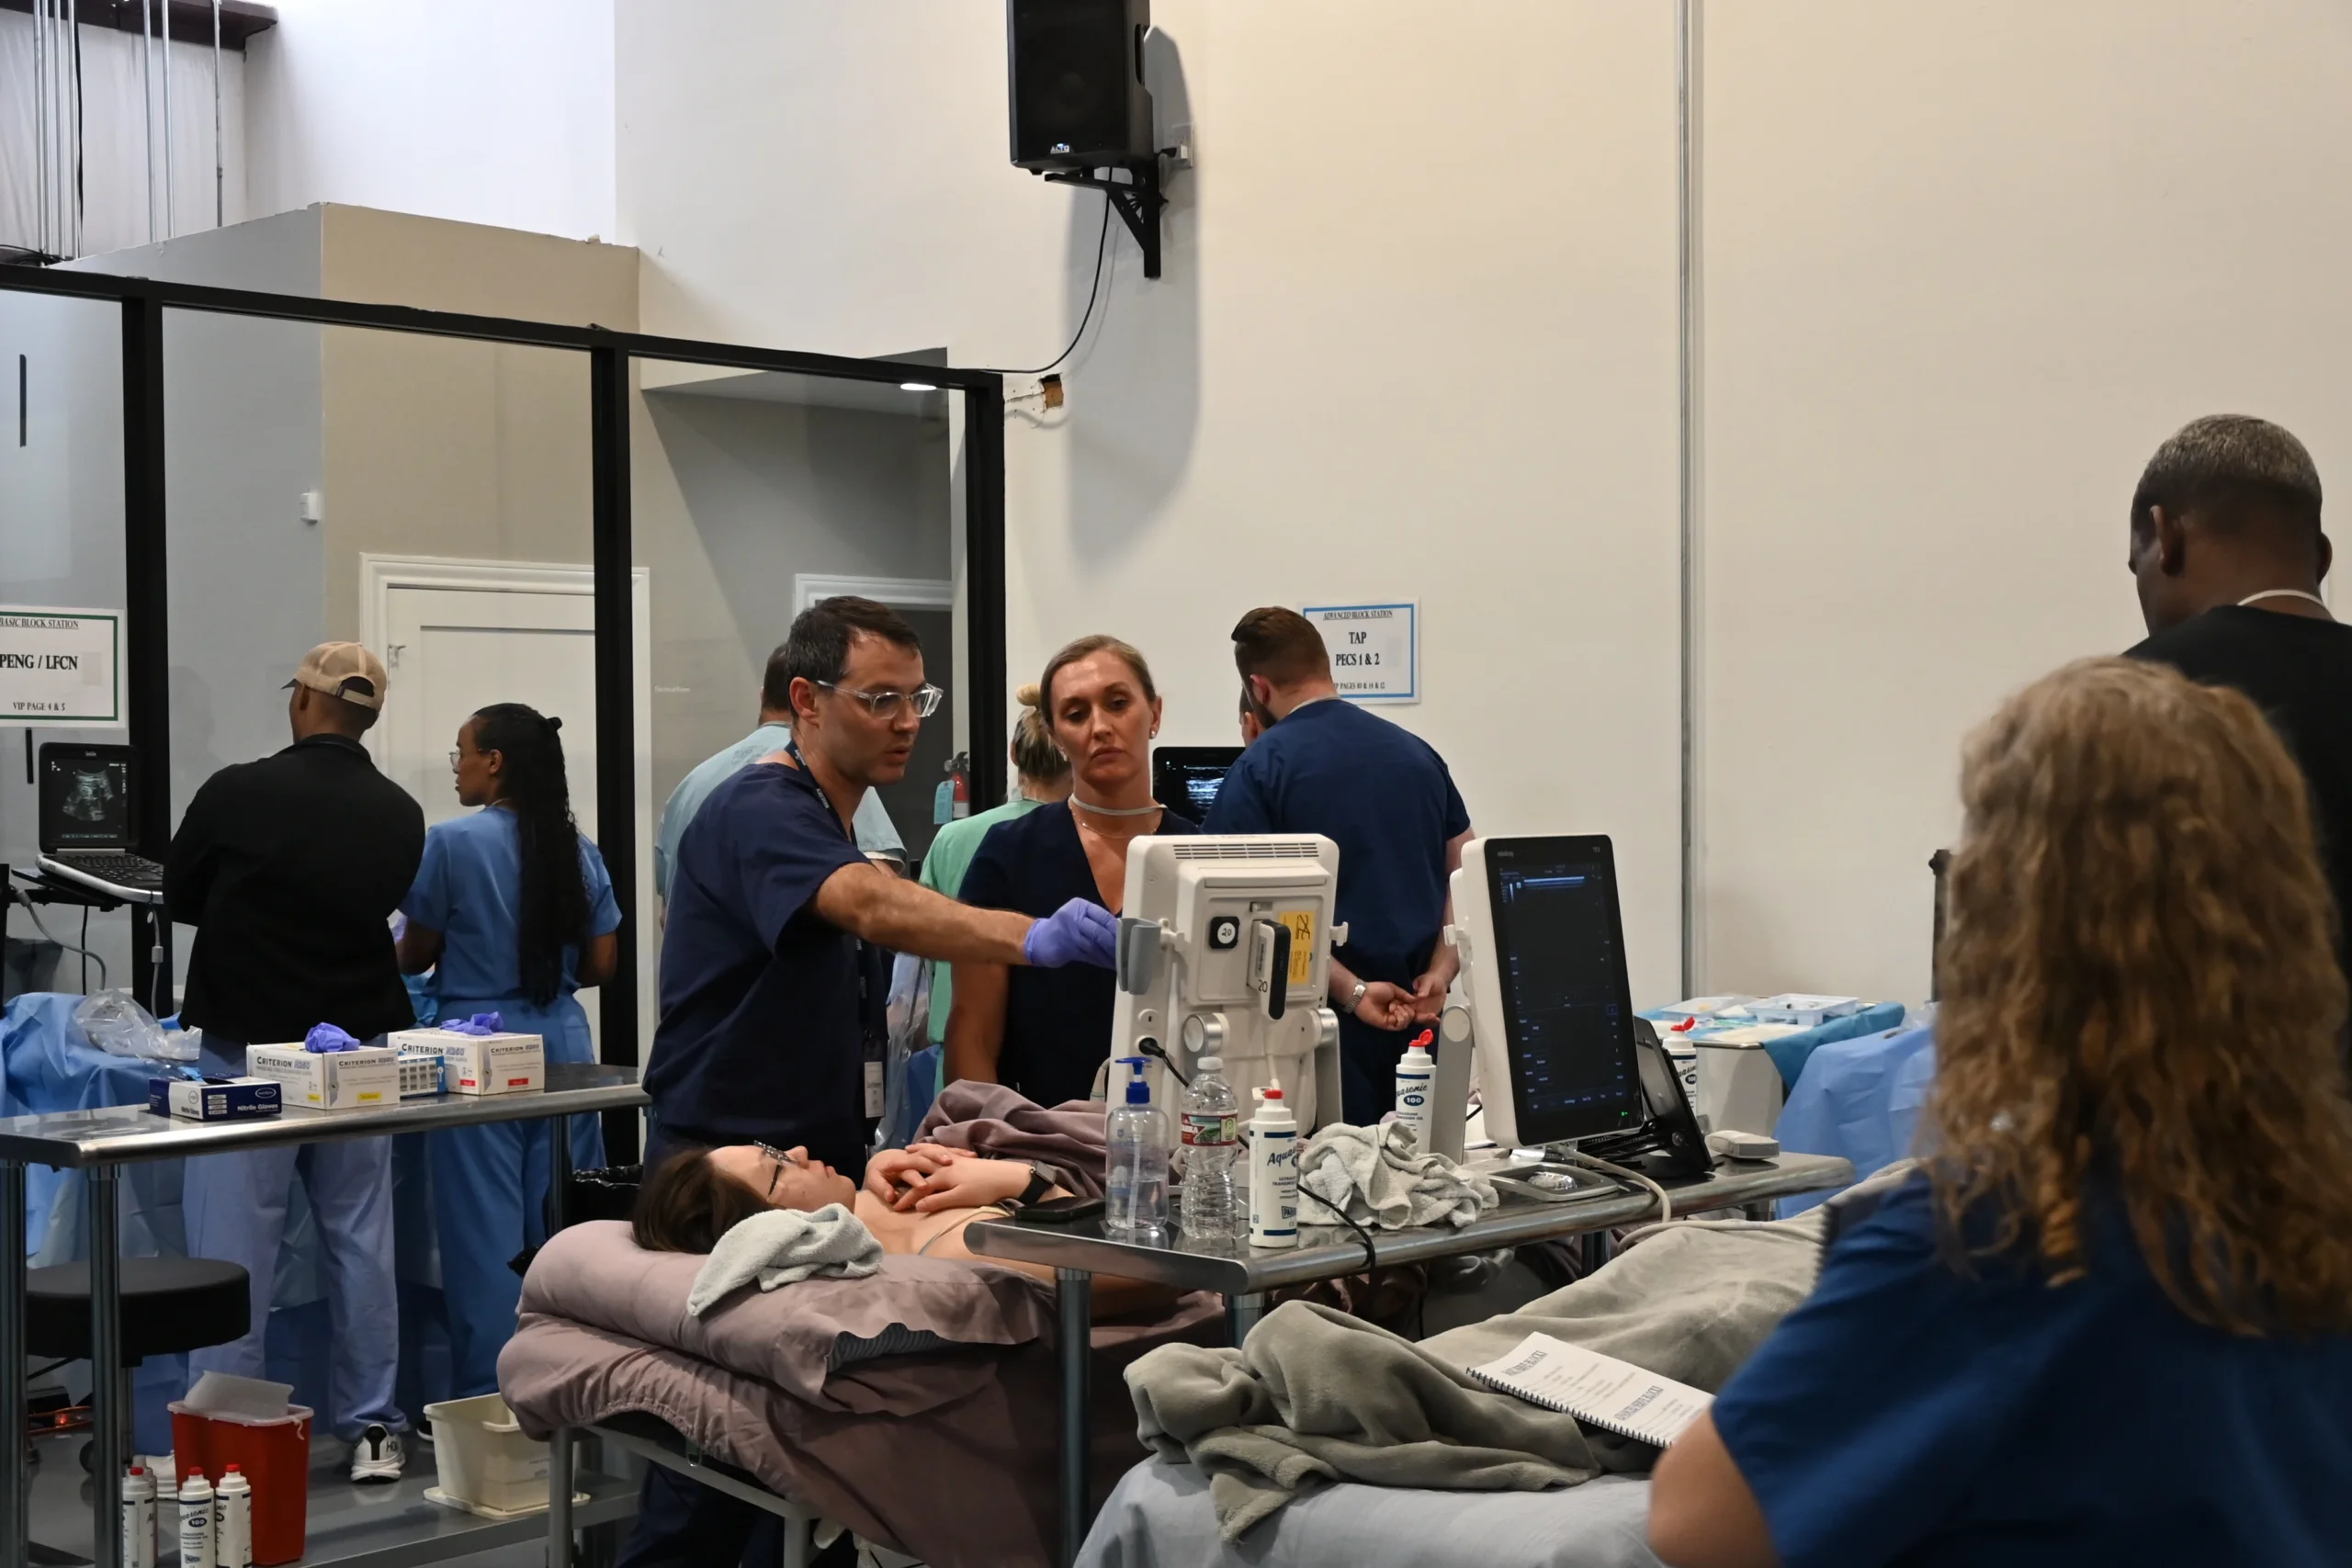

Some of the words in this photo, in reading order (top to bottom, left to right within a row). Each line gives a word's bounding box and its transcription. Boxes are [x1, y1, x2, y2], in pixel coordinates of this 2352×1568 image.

[1370, 610, 1393, 618] STATION
[21, 618, 46, 627] BLOCK
[48, 619, 78, 629] STATION
[1349, 631, 1367, 644] TAP
[0, 654, 34, 669] PENG
[38, 655, 42, 669] /
[46, 655, 78, 670] LFCN
[1336, 653, 1357, 666] PECS
[1359, 653, 1363, 666] 1
[1364, 653, 1373, 665] &
[1374, 652, 1380, 665] 2
[13, 702, 25, 710] VIP
[27, 703, 45, 711] PAGE
[53, 703, 59, 711] &
[61, 703, 65, 711] 5
[1222, 928, 1232, 938] 20
[1258, 978, 1268, 993] 20
[401, 1043, 443, 1055] CRITERION
[257, 1056, 292, 1067] CRITERION
